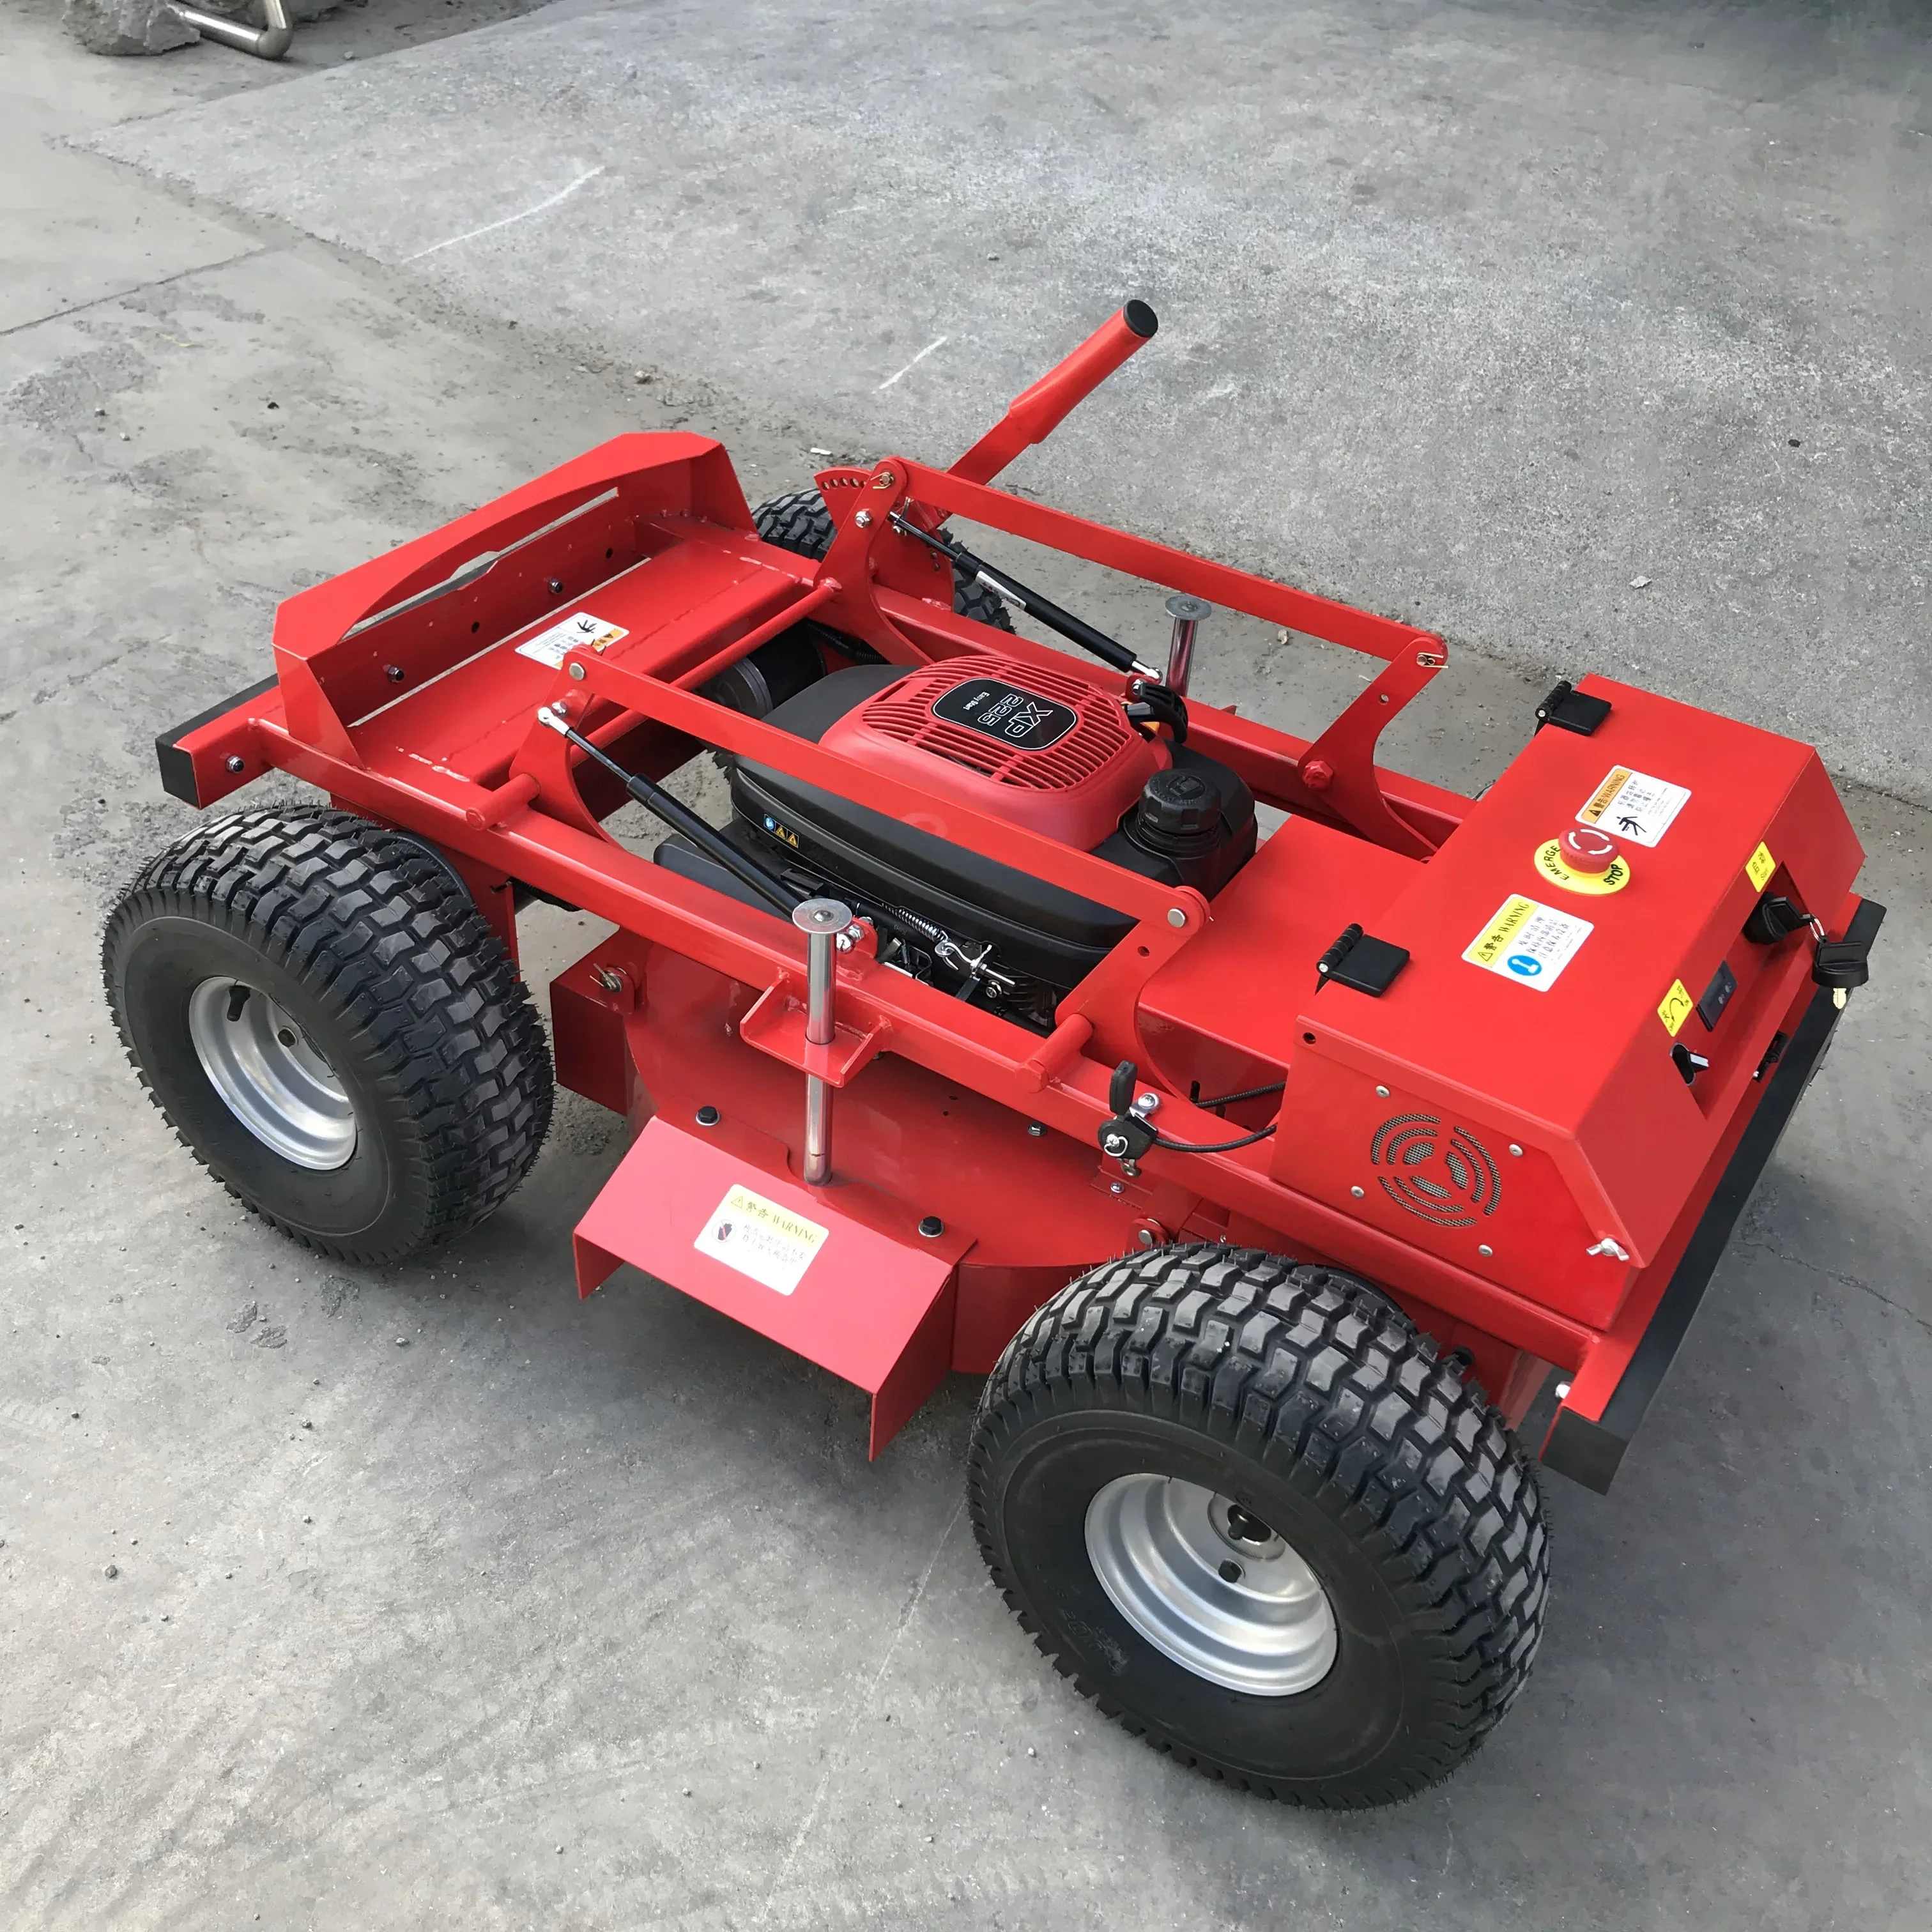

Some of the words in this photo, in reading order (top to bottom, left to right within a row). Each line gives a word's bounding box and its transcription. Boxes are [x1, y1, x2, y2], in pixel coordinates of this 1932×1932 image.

[973, 691, 990, 702] Easy
[977, 693, 1023, 726] 225
[1005, 702, 1054, 738] XP
[1544, 845, 1570, 880] EMERGE
[1603, 863, 1623, 885] STOP
